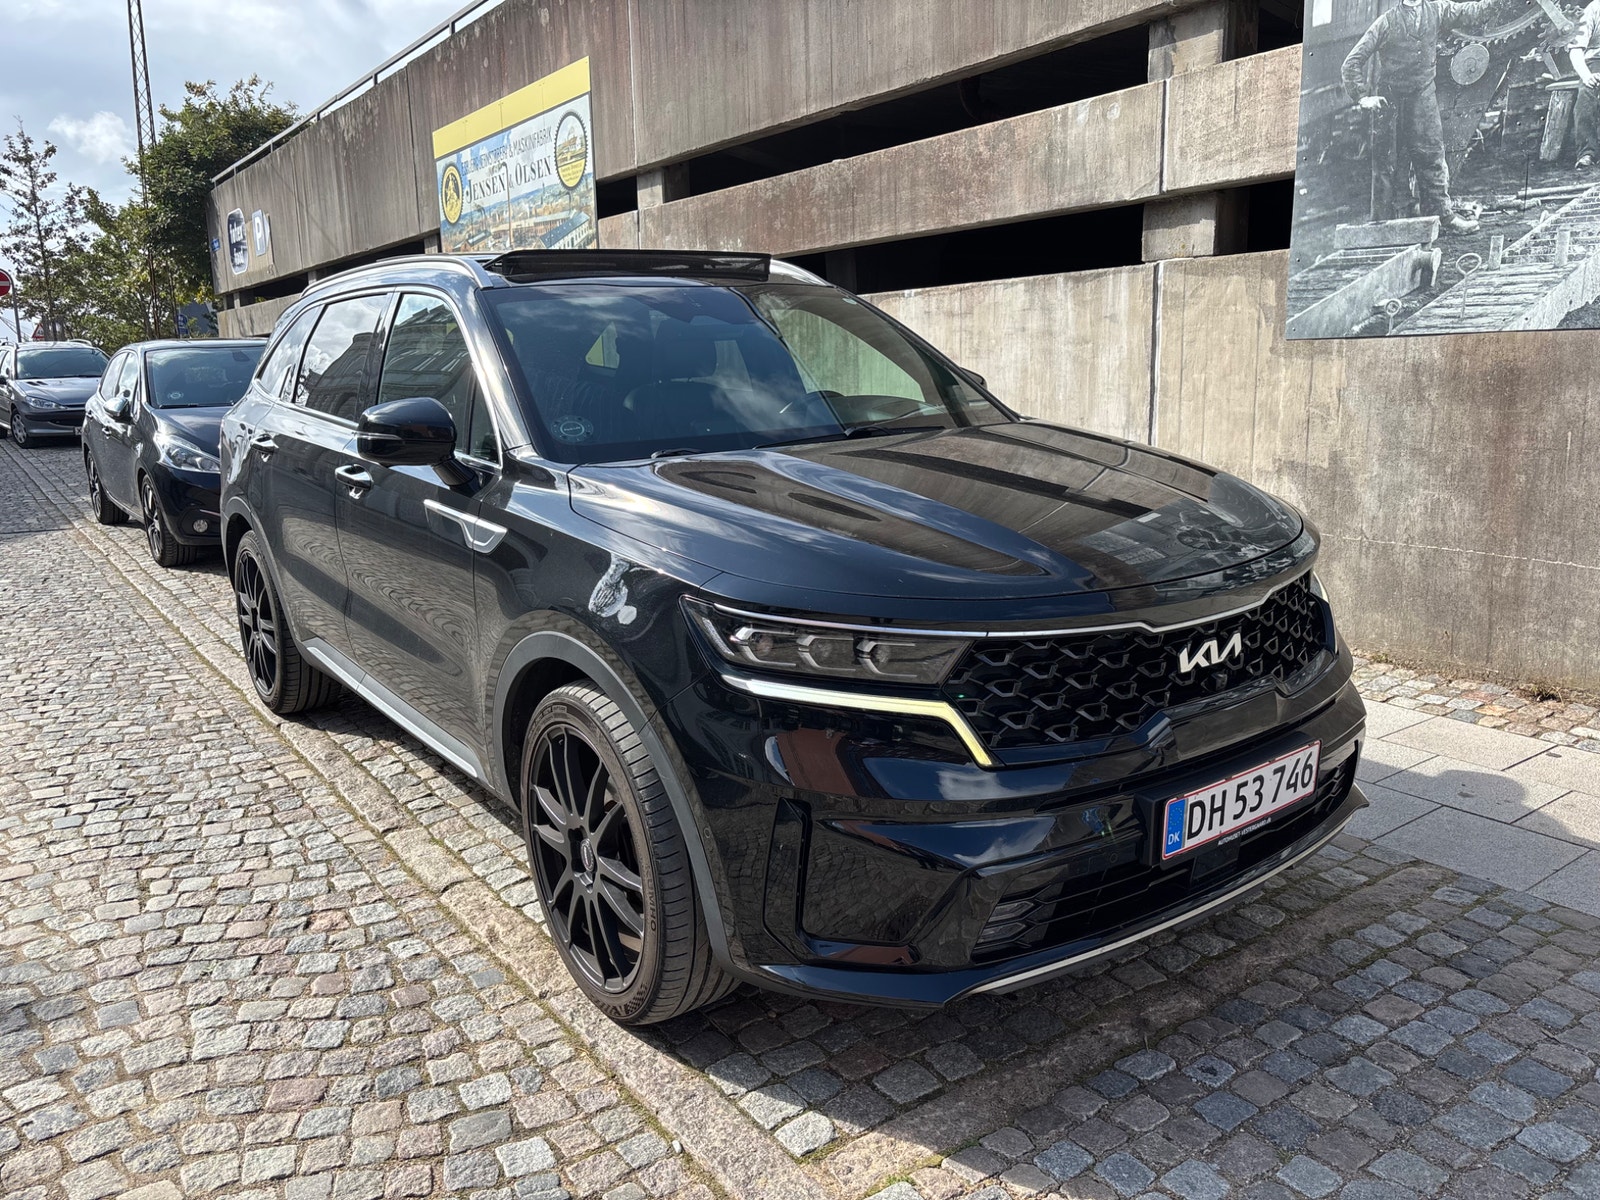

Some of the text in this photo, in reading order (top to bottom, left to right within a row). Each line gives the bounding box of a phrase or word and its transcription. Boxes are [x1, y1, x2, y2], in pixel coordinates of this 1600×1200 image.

[465, 173, 506, 204] JENSEN
[515, 156, 552, 186] OLSEN
[254, 216, 263, 251] P
[1179, 632, 1242, 673] KIA
[1187, 751, 1314, 841] DH 53 746
[1167, 831, 1180, 846] DK
